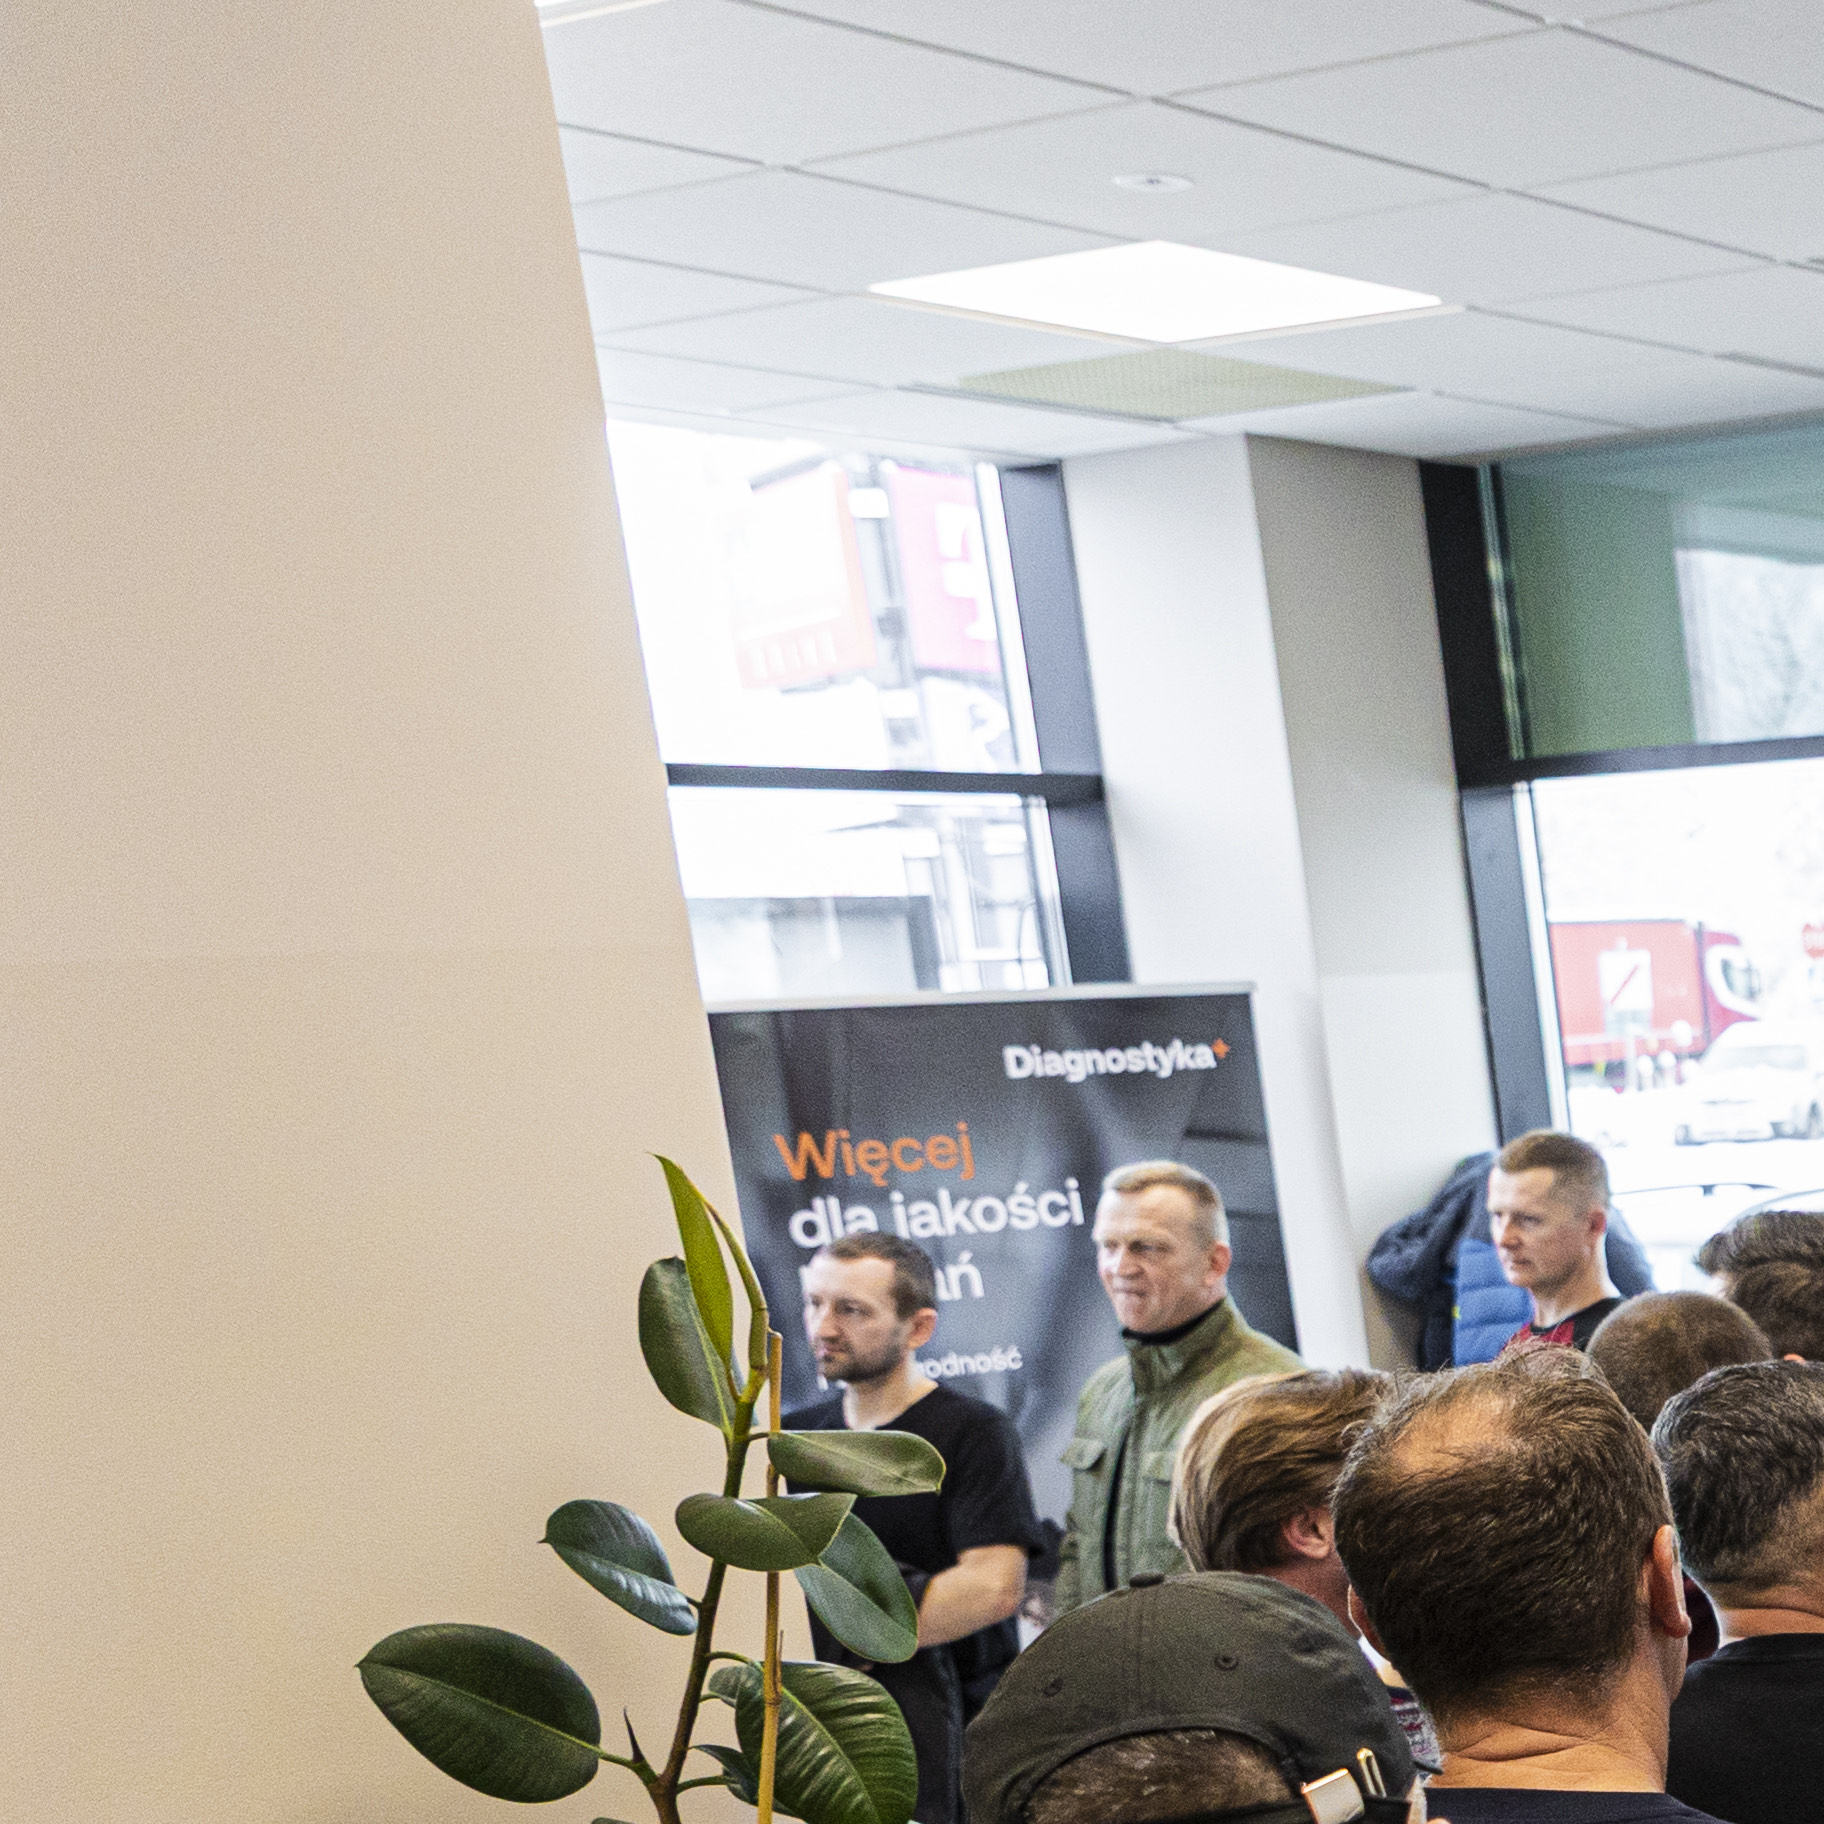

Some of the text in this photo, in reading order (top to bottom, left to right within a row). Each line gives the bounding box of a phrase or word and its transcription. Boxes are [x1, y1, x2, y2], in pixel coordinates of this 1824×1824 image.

[1003, 1037, 1217, 1083] Diagnostyka
[773, 1121, 975, 1187] Więcej
[789, 1196, 879, 1248] dla
